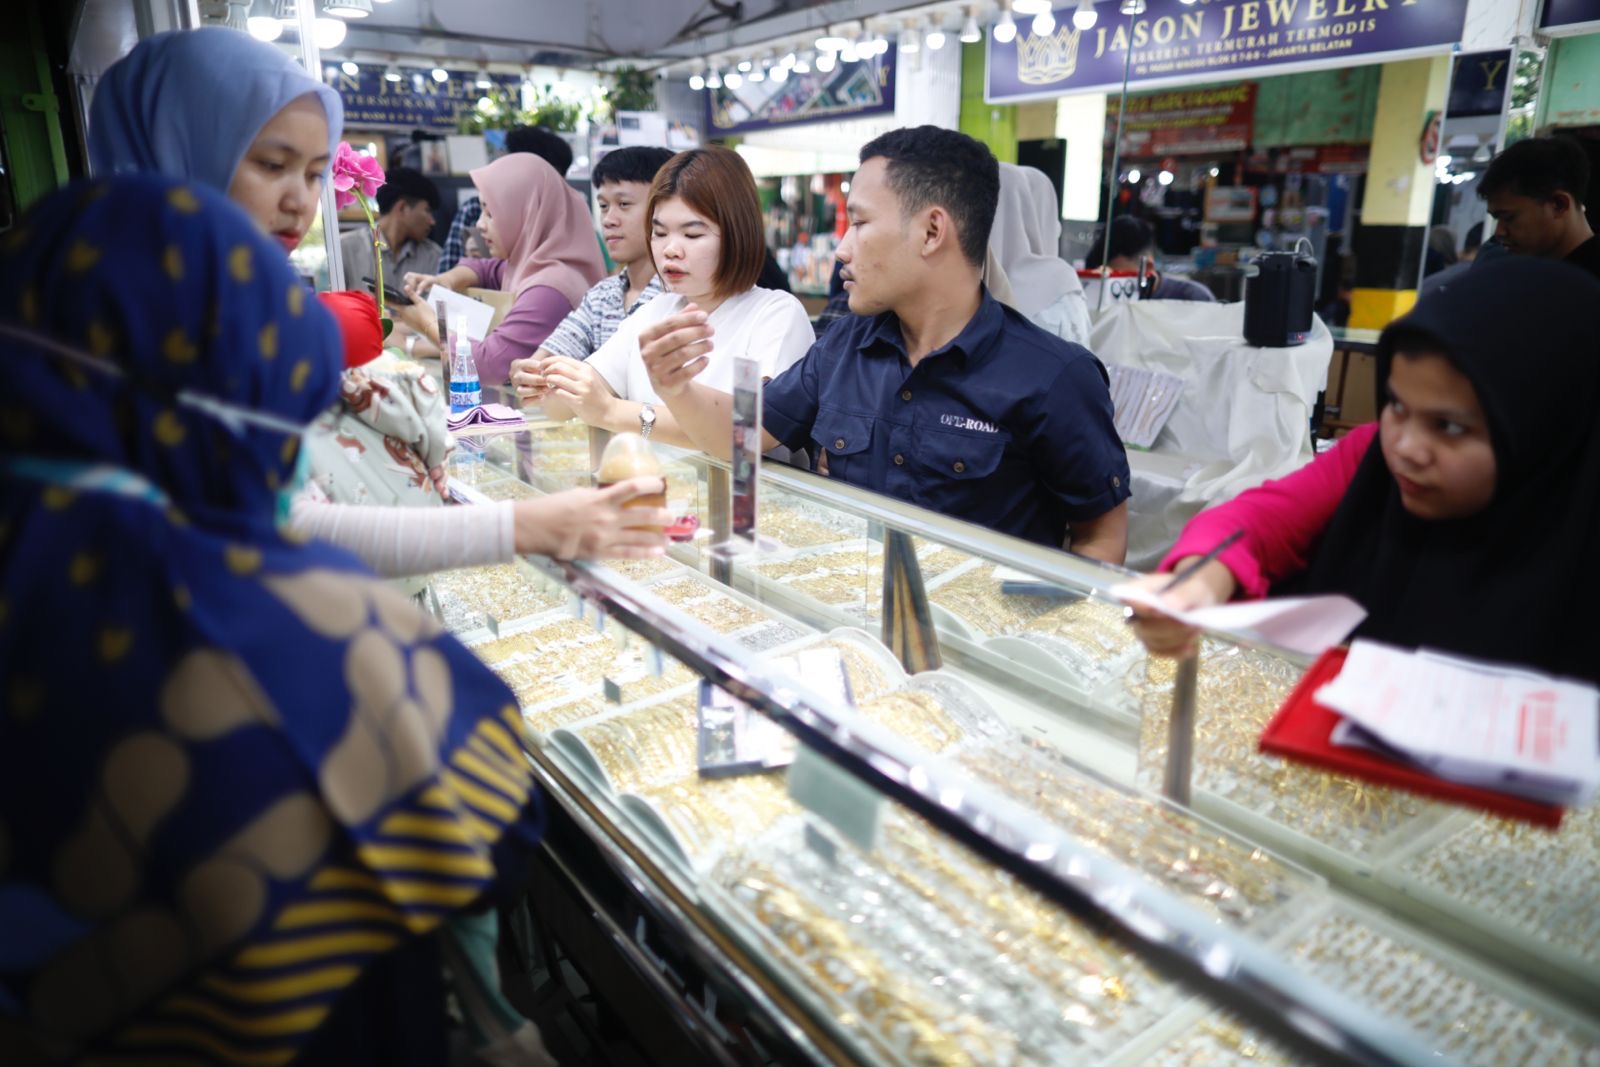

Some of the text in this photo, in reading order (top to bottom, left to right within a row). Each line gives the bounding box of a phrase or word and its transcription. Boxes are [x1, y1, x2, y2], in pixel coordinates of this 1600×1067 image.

[1094, 10, 1205, 58] JASON
[1196, 32, 1279, 55] TERMURAH
[1286, 18, 1376, 43] TERMODIS
[1267, 45, 1308, 58] JAKARTA
[1309, 39, 1353, 52] SELATAN
